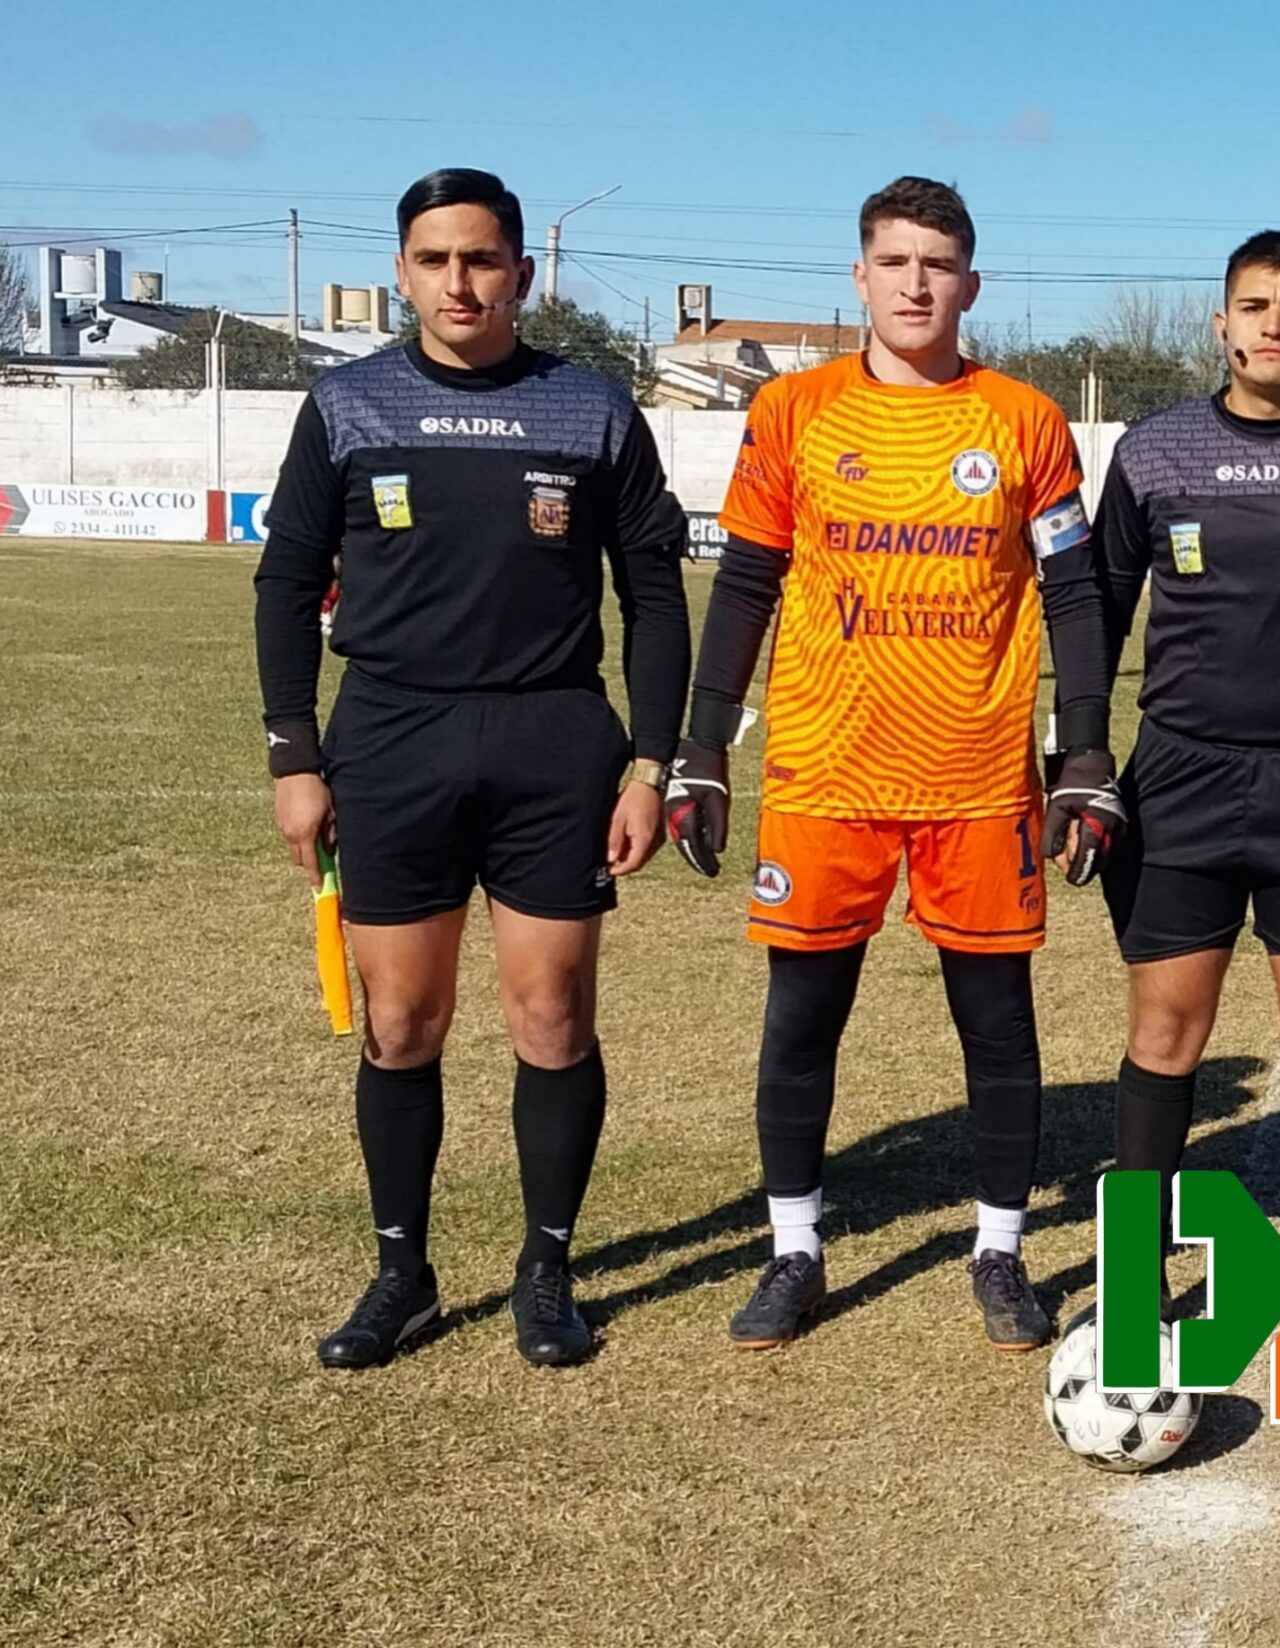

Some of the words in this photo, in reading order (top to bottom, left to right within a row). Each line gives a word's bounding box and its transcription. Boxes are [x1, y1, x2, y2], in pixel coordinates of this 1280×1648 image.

[439, 416, 527, 437] SADRA
[31, 488, 104, 507] ULISES
[108, 490, 196, 509] GACCIO
[70, 521, 101, 537] 2334
[855, 521, 999, 558] DANOMET
[1015, 815, 1037, 878] 1
